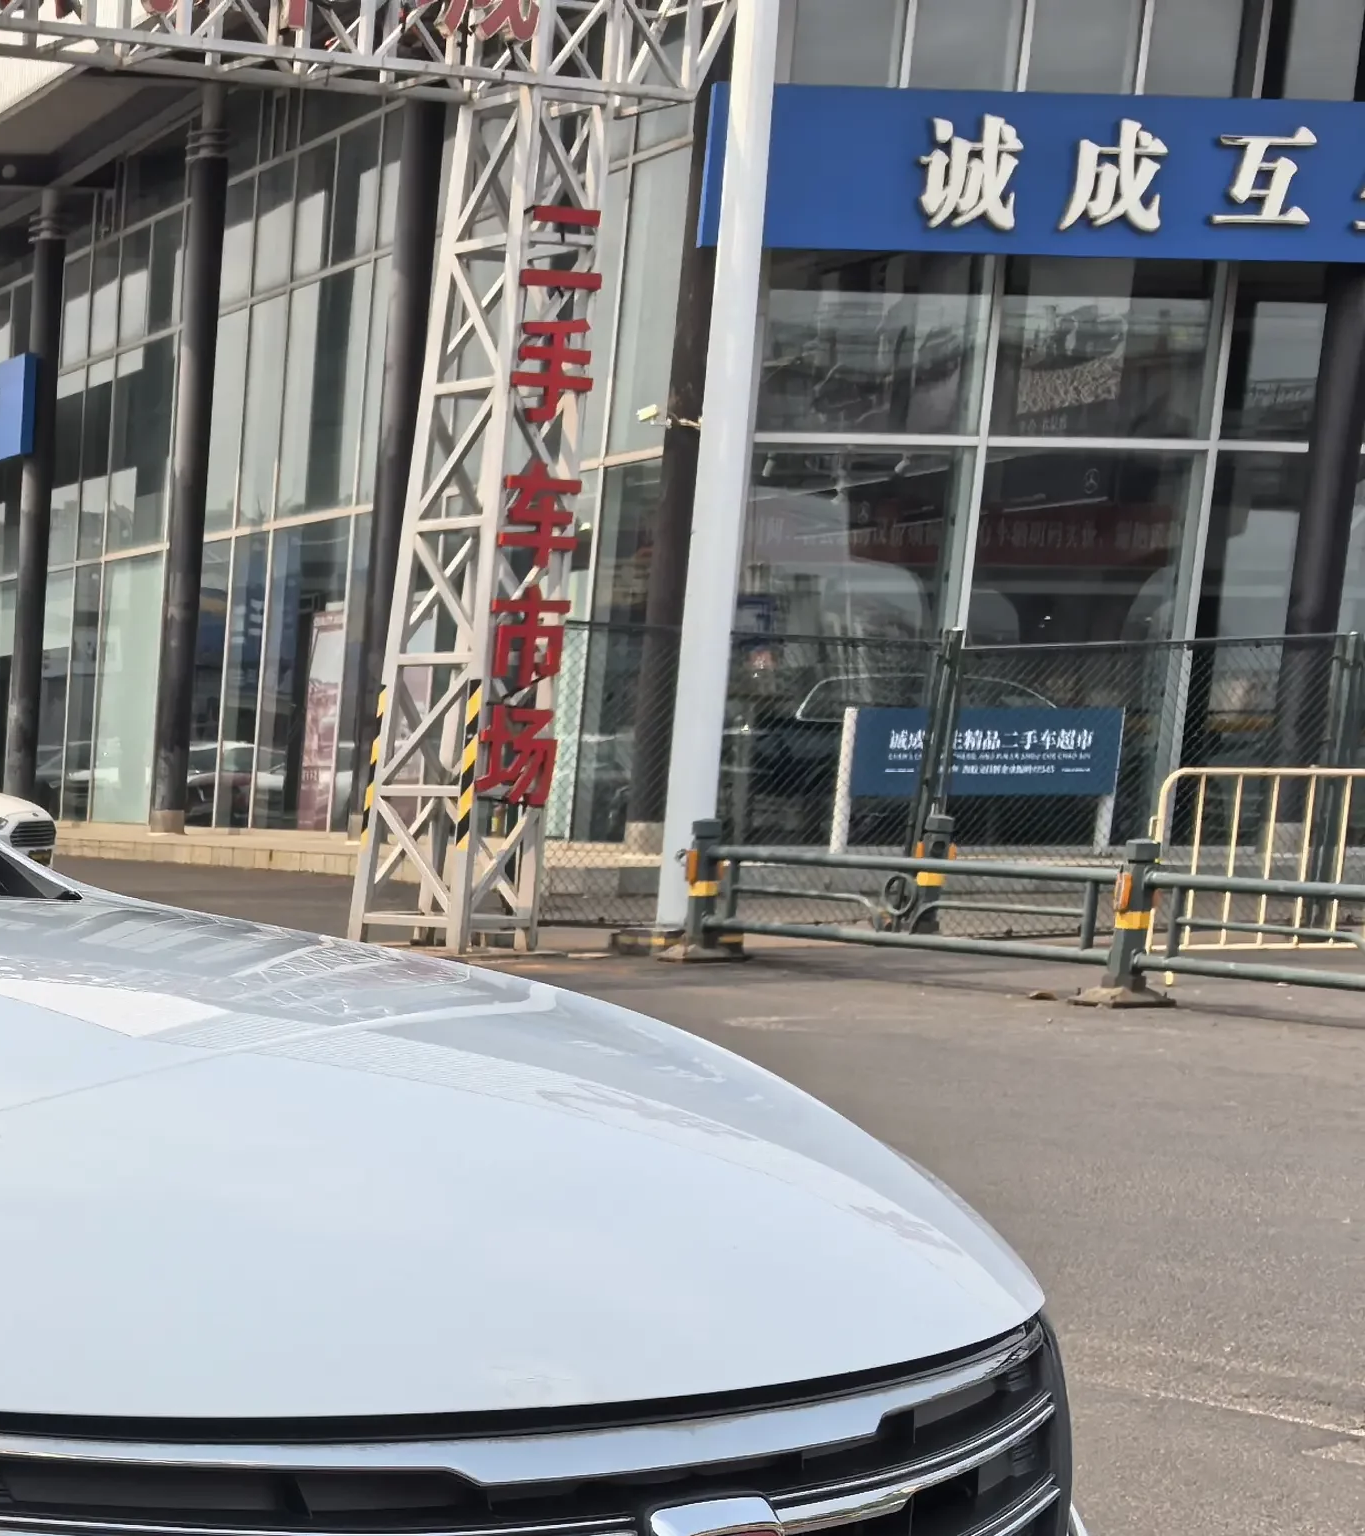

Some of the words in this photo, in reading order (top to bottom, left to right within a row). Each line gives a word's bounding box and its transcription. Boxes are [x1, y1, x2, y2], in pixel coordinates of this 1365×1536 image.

[918, 113, 1365, 232] 诚成互
[474, 205, 603, 808] 二手车市场
[889, 729, 1094, 750] 诚成生精品二手车超市
